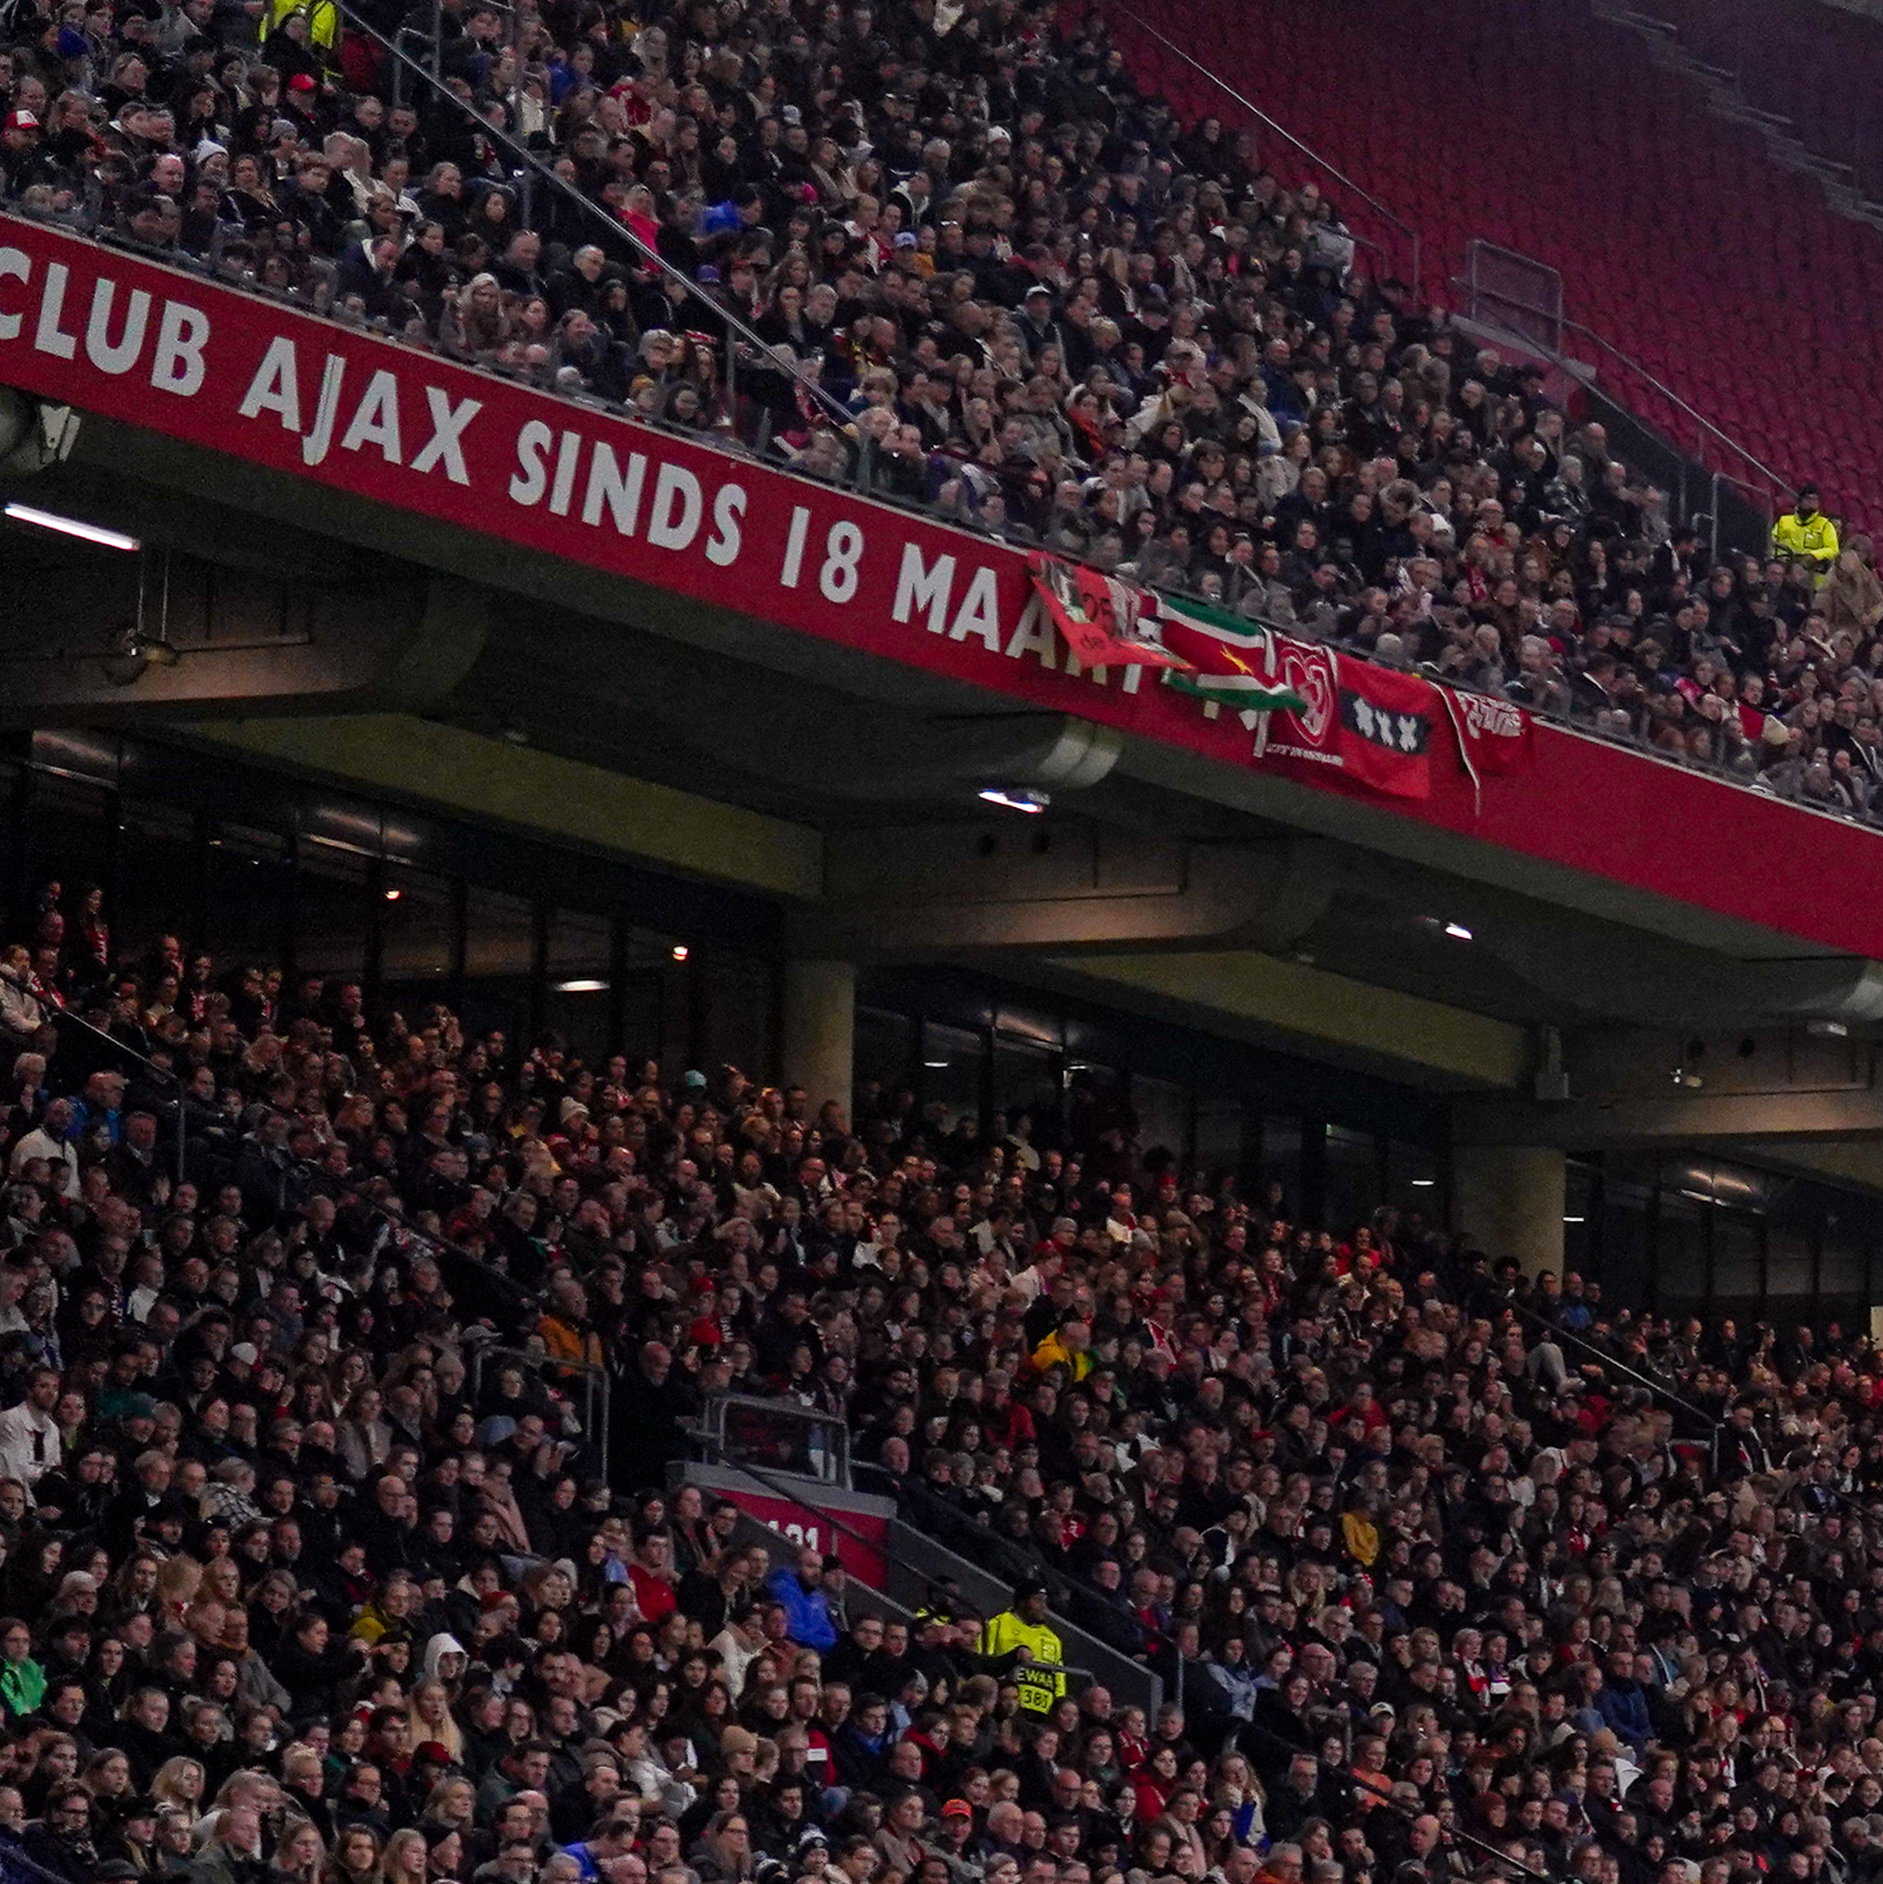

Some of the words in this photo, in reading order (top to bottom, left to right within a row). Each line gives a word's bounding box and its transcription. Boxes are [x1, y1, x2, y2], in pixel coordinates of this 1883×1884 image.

[0, 247, 211, 397] CLUB
[239, 337, 482, 485] AJAX
[508, 420, 748, 566] SINDS
[782, 507, 862, 602] 18
[891, 543, 1143, 695] MAA
